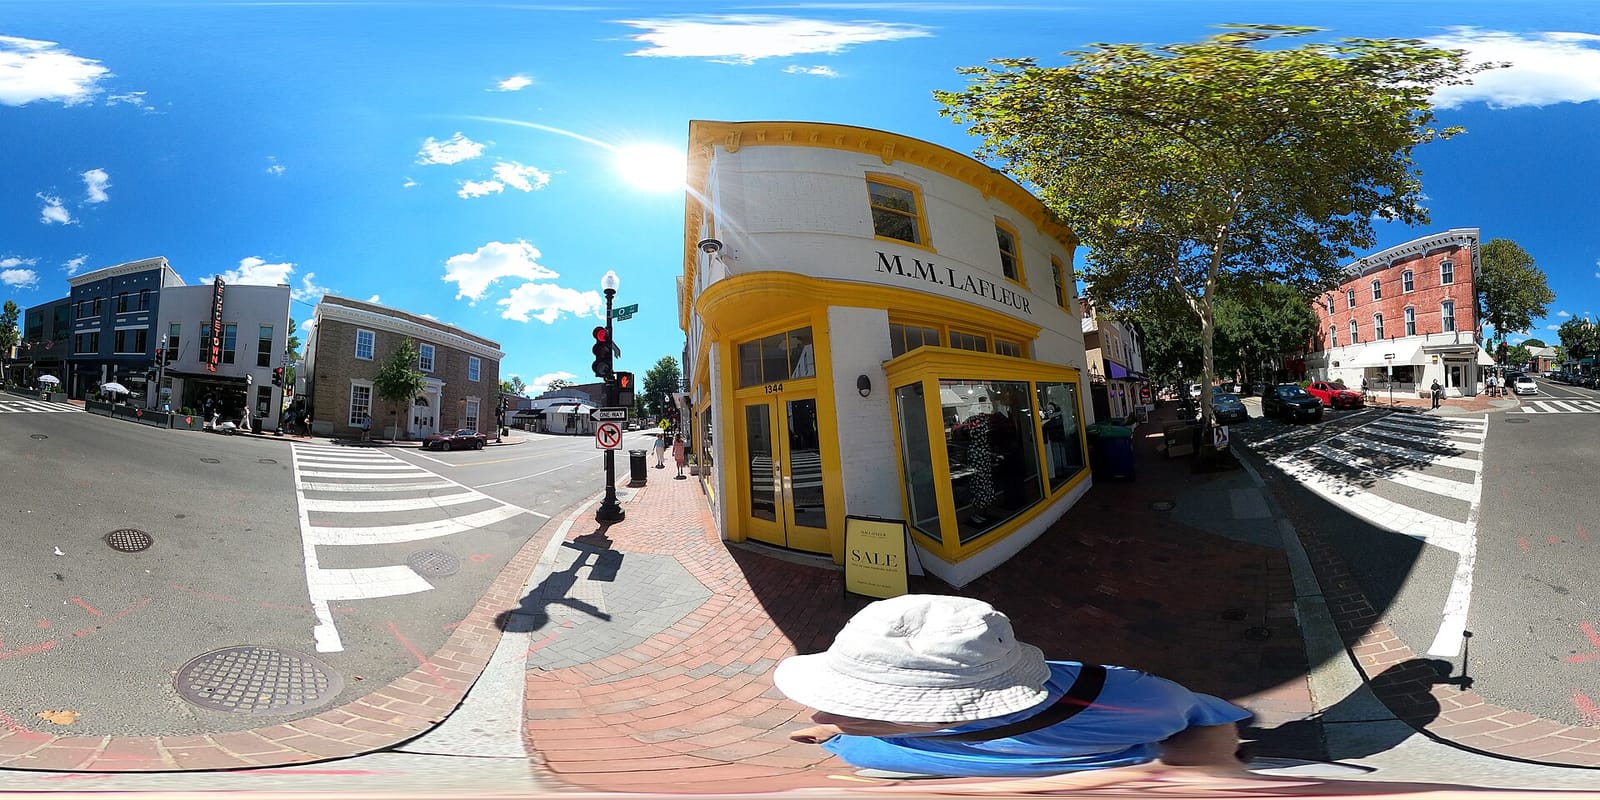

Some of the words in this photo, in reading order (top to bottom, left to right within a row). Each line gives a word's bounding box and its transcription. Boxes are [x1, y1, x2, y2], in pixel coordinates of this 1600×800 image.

[875, 251, 944, 285] M.M.
[945, 267, 1033, 315] LAFLEUR
[211, 277, 225, 365] GEORGETOWN
[764, 383, 784, 394] 1344
[851, 549, 898, 568] SALE
